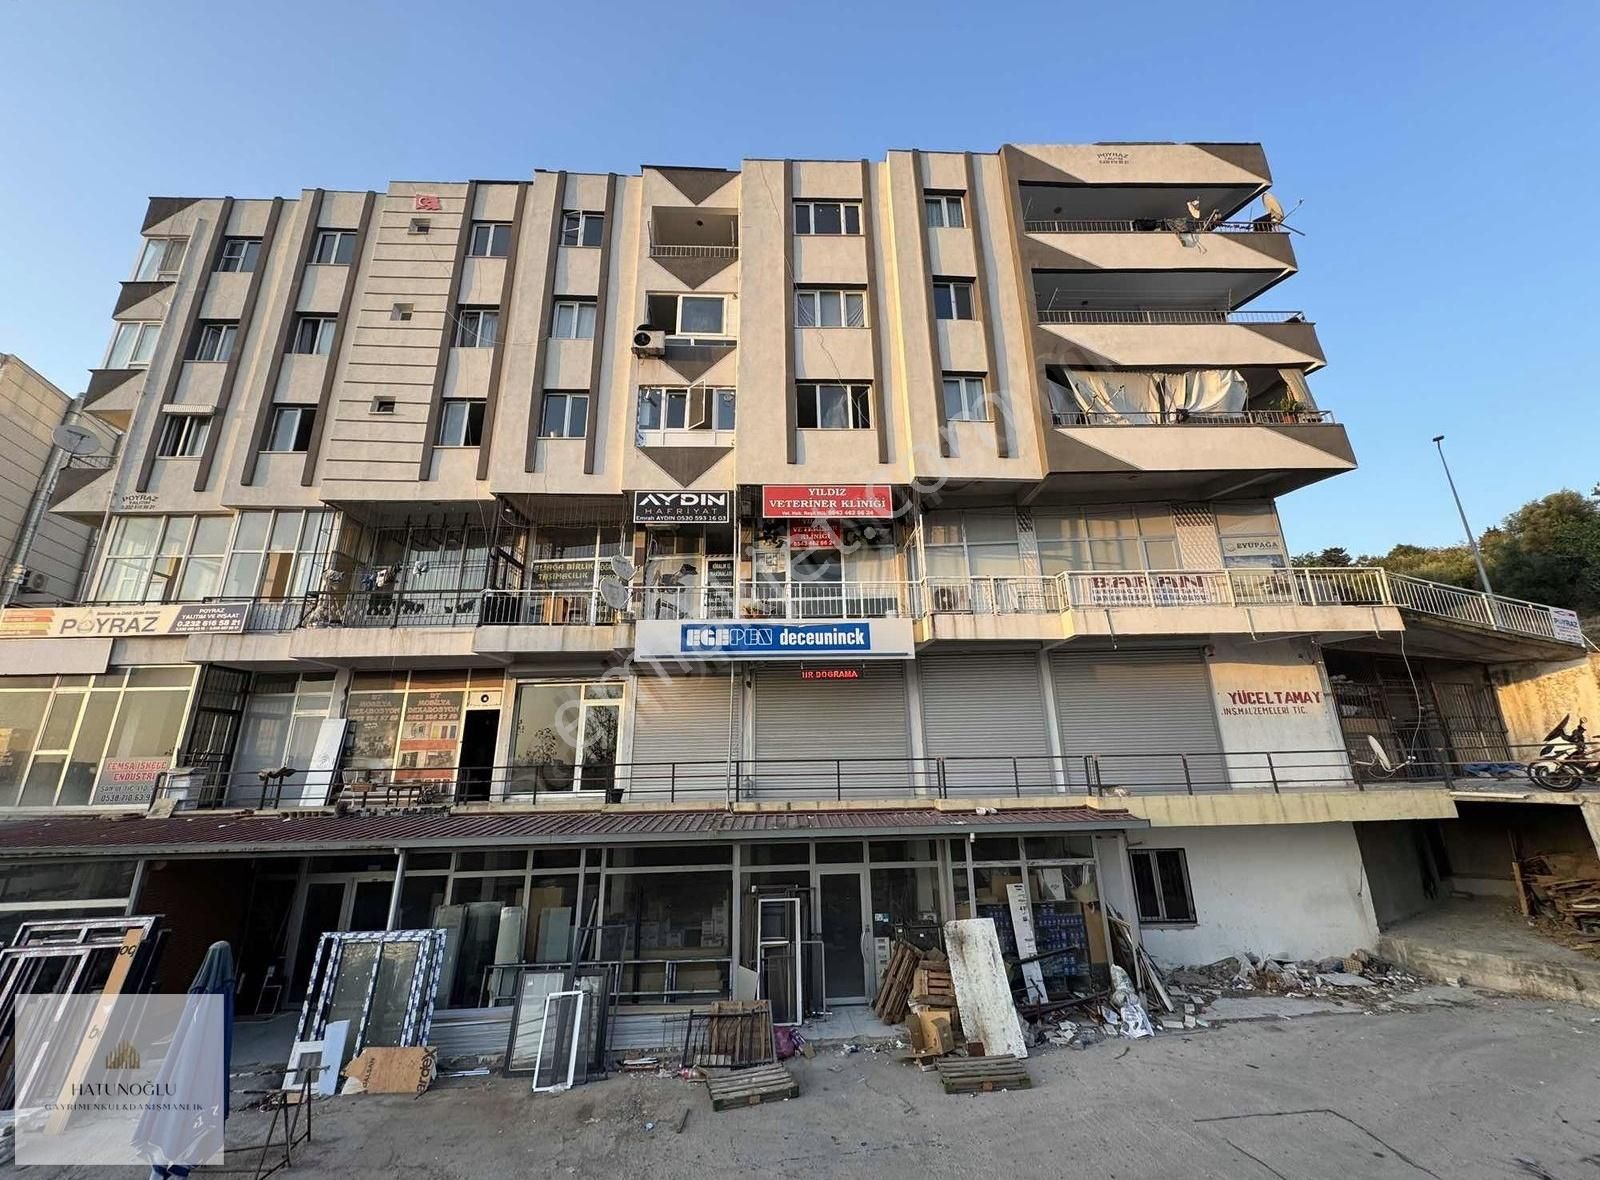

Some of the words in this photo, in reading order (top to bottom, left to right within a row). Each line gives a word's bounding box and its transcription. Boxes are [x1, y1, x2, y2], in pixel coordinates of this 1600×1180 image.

[808, 488, 846, 496] YILDIZ
[639, 493, 725, 505] AYDIN
[769, 499, 837, 508] VETERİNER
[645, 506, 717, 514] HAFRİYAT
[60, 616, 159, 634] POYRAZ
[686, 628, 773, 646] EGEPEN
[780, 627, 864, 645] deceuninck
